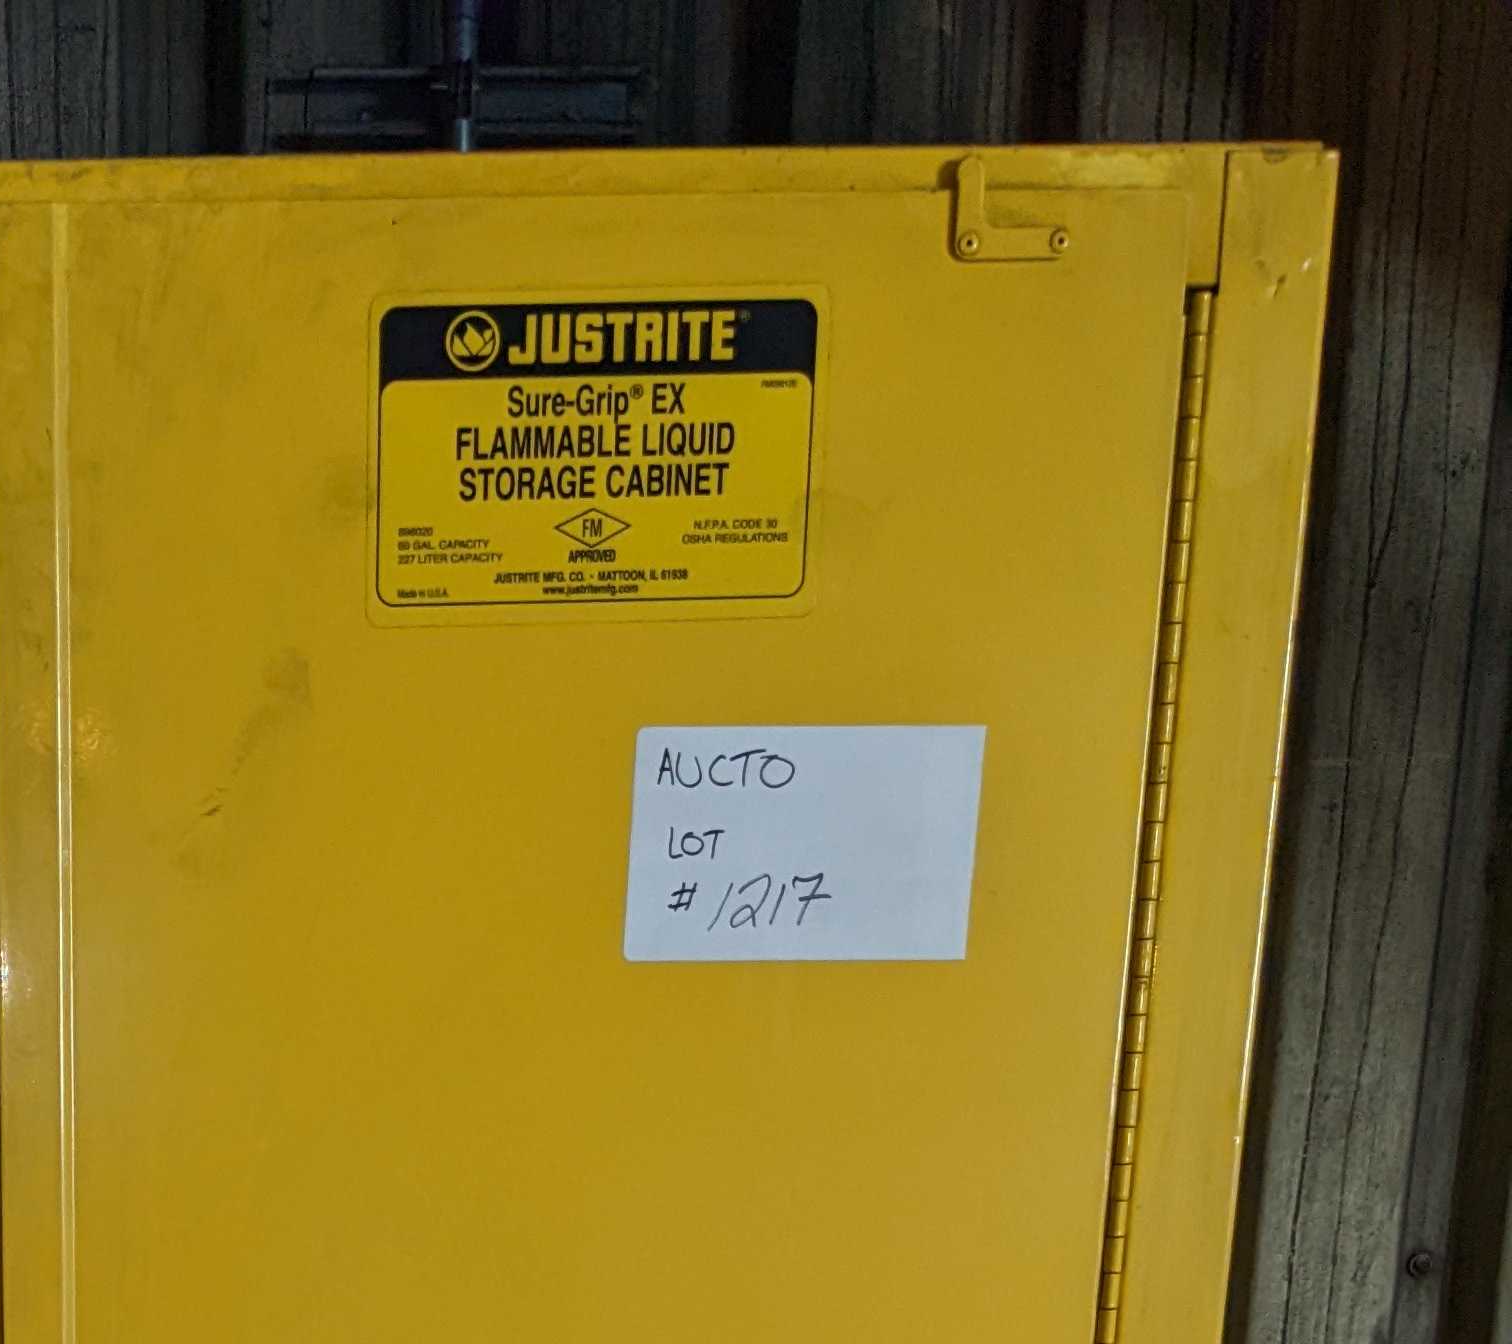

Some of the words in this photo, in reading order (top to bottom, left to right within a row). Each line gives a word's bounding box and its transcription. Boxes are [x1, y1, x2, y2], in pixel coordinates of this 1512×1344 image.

[651, 383, 686, 415] EX
[456, 423, 631, 461] FLAMMABLE
[642, 422, 736, 457] LIQUID
[459, 466, 596, 502] STORAGE
[606, 462, 730, 498] CABINET
[582, 518, 603, 538] FM
[439, 539, 490, 550] CAPACITY
[568, 548, 617, 564] APPROVED
[418, 553, 448, 564] LITER
[450, 552, 504, 563] CAPACITY
[494, 571, 539, 584] JUSTRITE
[657, 747, 796, 789] AUCTO
[668, 826, 726, 860] LOT
